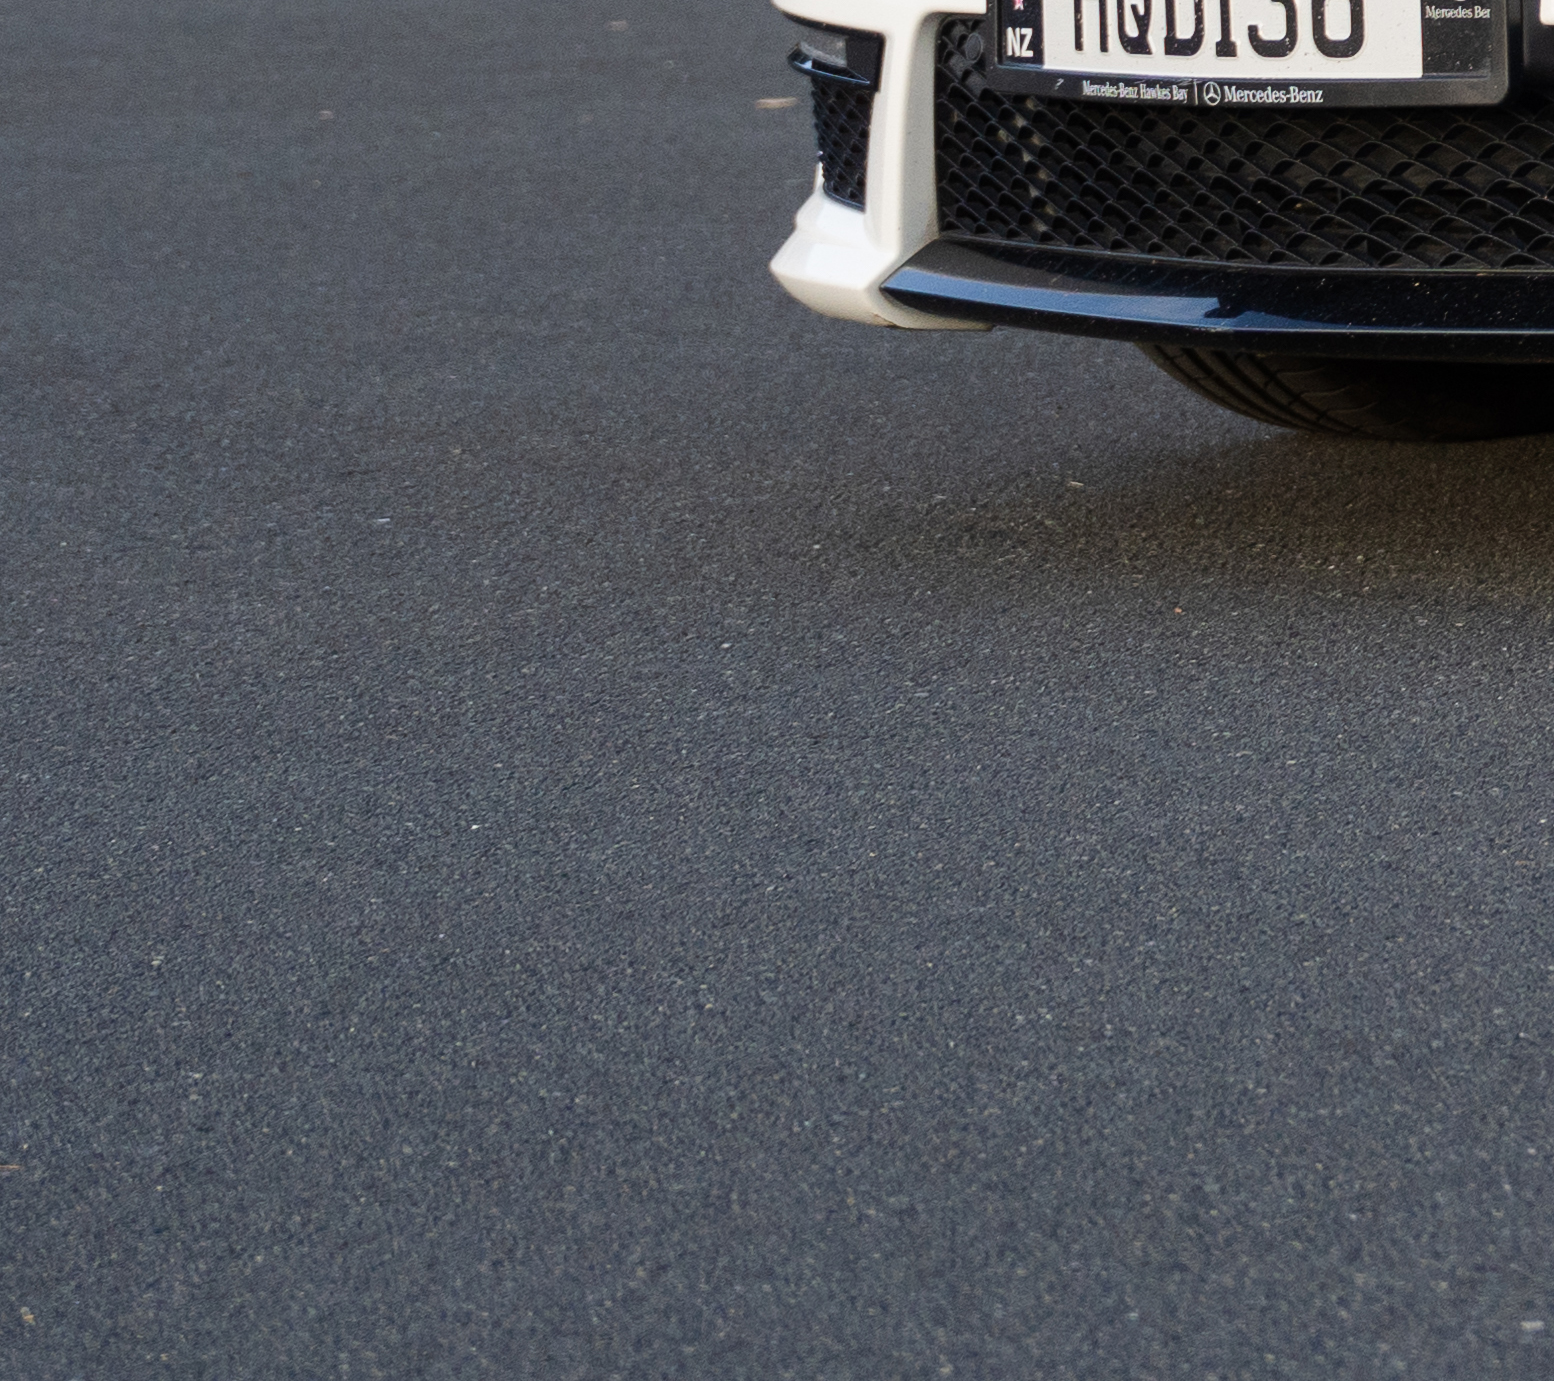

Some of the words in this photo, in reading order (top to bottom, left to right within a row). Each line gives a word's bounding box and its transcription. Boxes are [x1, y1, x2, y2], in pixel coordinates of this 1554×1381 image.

[1425, 5, 1472, 20] Mercedes
[1006, 26, 1034, 58] NZ
[1082, 79, 1138, 100] Mercedes-Benz
[1139, 83, 1170, 101] Hawkes
[1171, 85, 1188, 104] Bay
[1224, 85, 1324, 104] Mercedes-Benz
